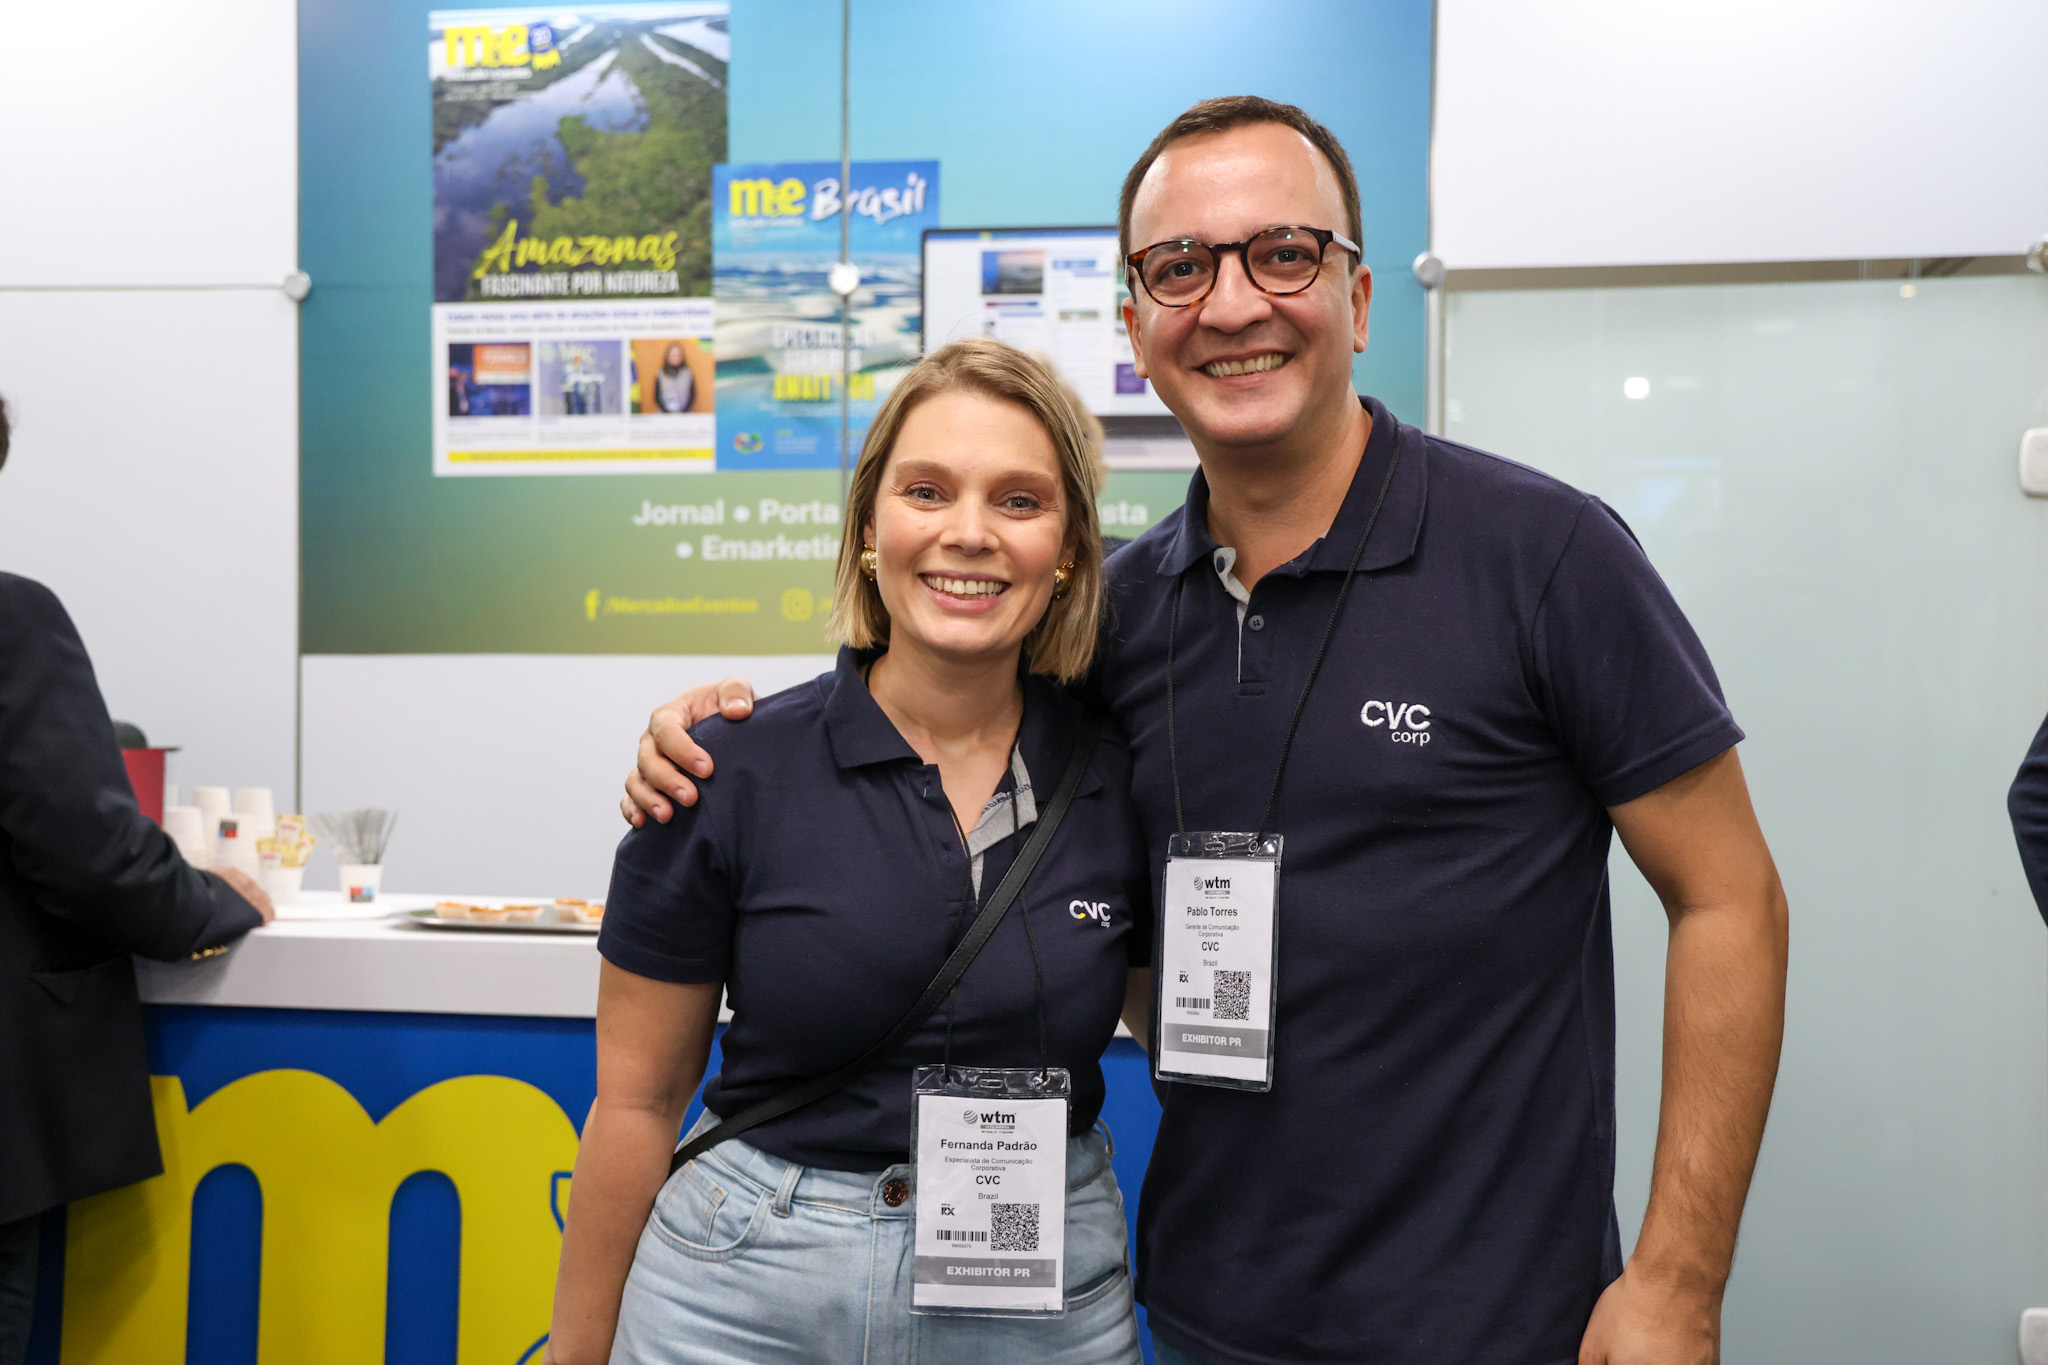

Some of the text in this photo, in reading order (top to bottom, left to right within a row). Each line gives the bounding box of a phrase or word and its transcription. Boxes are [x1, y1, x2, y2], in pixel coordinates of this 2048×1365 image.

[810, 171, 927, 225] Brasil
[473, 218, 680, 279] Amazonas
[480, 270, 680, 297] FASCINANTE POR NATUREZA
[632, 499, 840, 526] Jornal Porta
[1360, 700, 1431, 730] CVC
[1391, 731, 1431, 746] corp
[1205, 876, 1231, 889] wtm
[1069, 899, 1111, 922] CVC
[1187, 906, 1238, 917] Pablo Torres
[1208, 923, 1240, 931] Comunicação
[1201, 941, 1220, 952] CVC
[1203, 959, 1218, 967] Brazil
[1182, 1033, 1242, 1047] EXHIBITOR PR
[980, 1110, 1015, 1124] wtm
[940, 1138, 1038, 1151] Fernanda Padrão
[944, 1156, 981, 1164] Especialista
[991, 1158, 1033, 1166] Comunicação
[970, 1164, 1006, 1172] Corporativa
[975, 1175, 1001, 1185] CVC
[978, 1192, 999, 1200] Brazil
[946, 1265, 1031, 1278] EXHIBITOR PR
